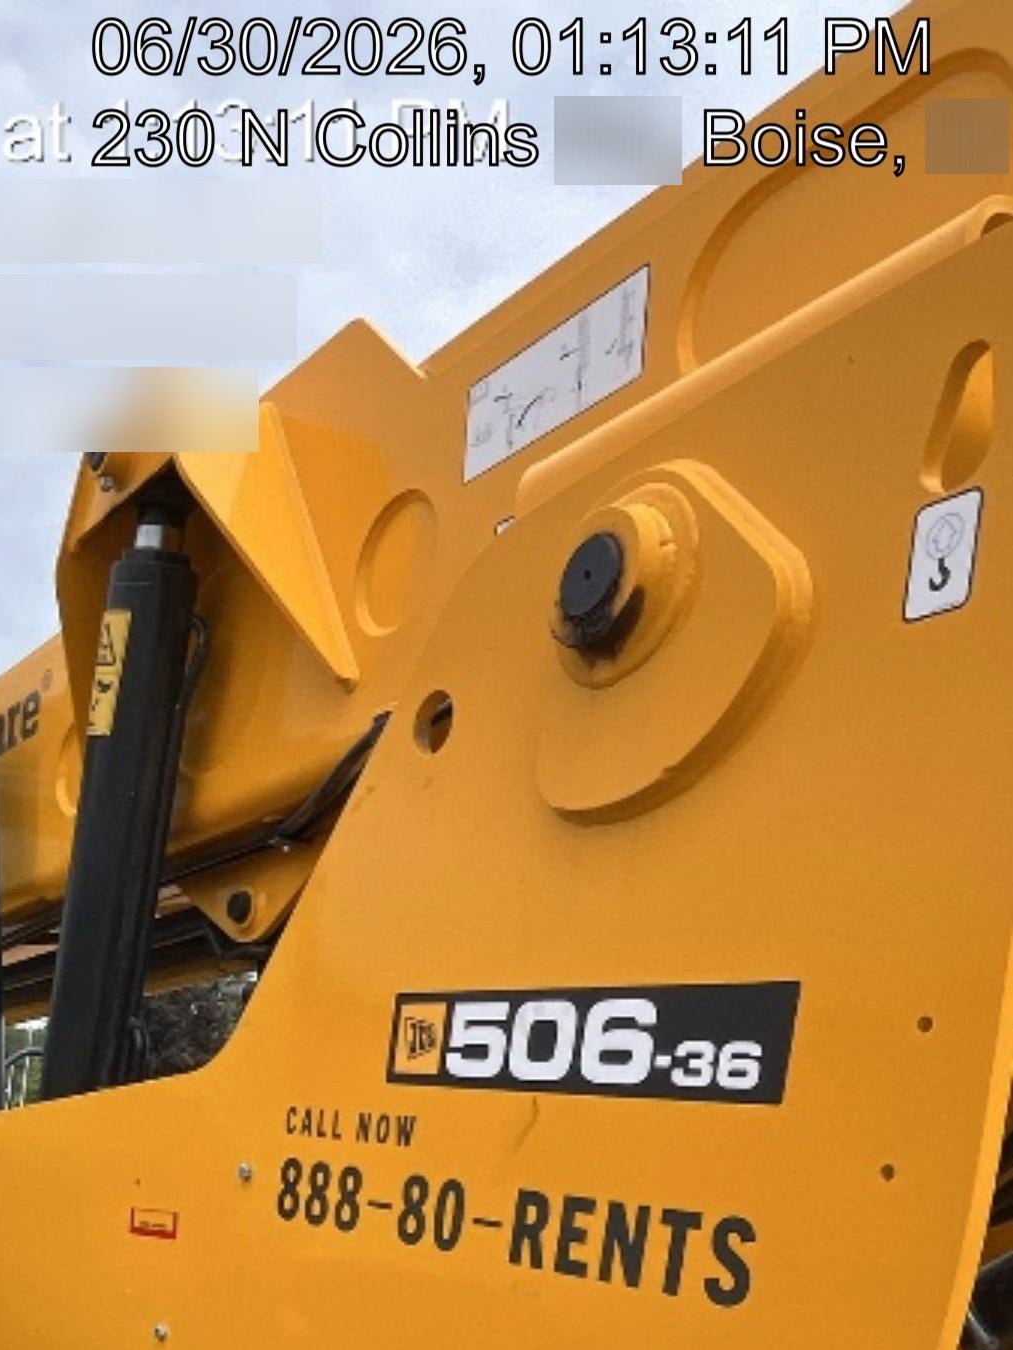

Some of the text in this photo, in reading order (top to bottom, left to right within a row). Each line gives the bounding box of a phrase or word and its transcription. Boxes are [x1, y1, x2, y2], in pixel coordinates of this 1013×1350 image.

[444, 998, 763, 1091] 506-36
[286, 1106, 418, 1148] CALL NOW
[276, 1157, 757, 1307] 888-80-RENTS
